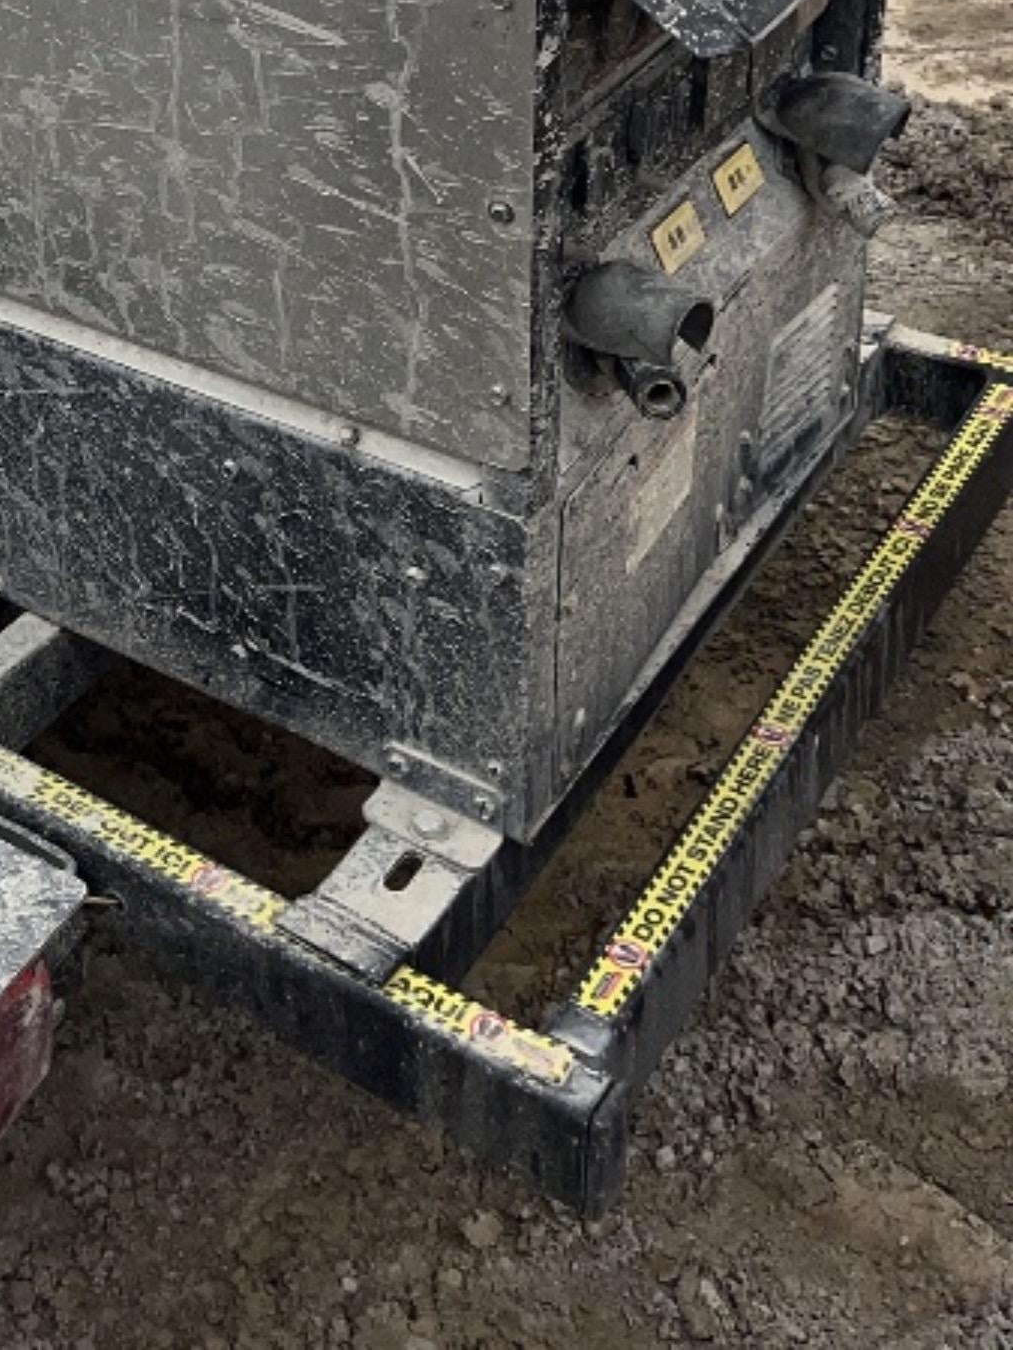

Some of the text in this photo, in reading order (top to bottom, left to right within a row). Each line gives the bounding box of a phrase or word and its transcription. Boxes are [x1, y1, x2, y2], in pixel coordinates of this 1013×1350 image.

[791, 664, 823, 700] PAS
[632, 747, 771, 943] DO NOT STAND HERE
